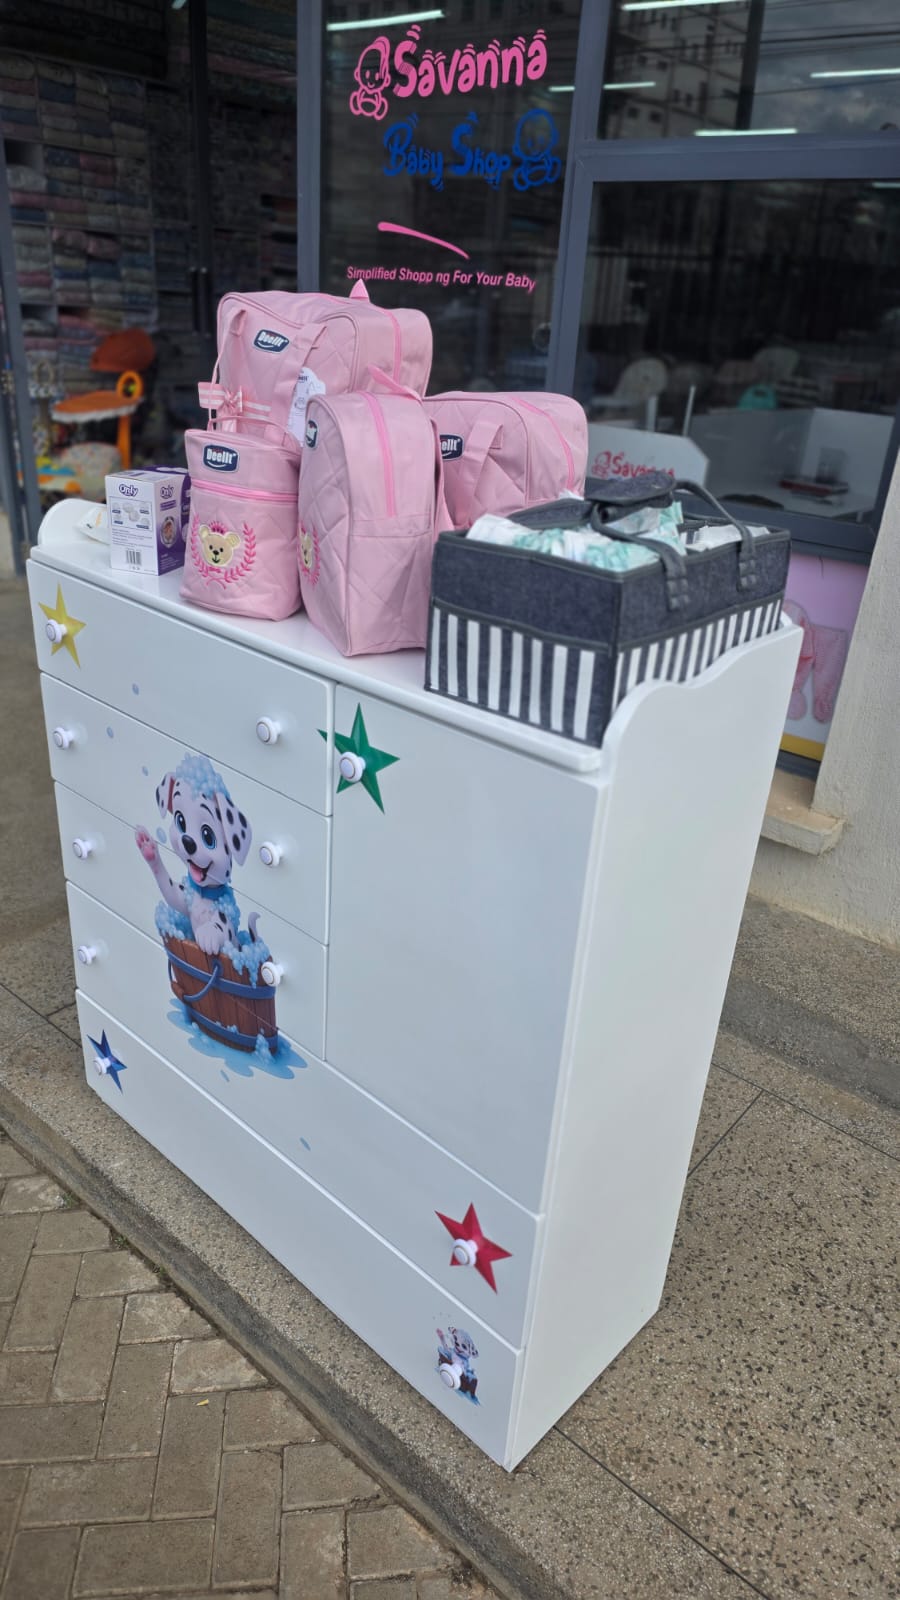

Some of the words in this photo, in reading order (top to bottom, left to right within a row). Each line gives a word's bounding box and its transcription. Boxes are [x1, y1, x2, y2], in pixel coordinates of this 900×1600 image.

[393, 29, 548, 98] Savanna
[383, 119, 444, 187] Baby
[448, 118, 511, 185] Shop
[347, 266, 396, 281] Simplified
[453, 270, 472, 284] For
[476, 272, 503, 286] Your
[505, 273, 536, 293] Baby
[441, 439, 457, 451] ellt
[119, 484, 139, 498] Only
[160, 485, 174, 499] Only
